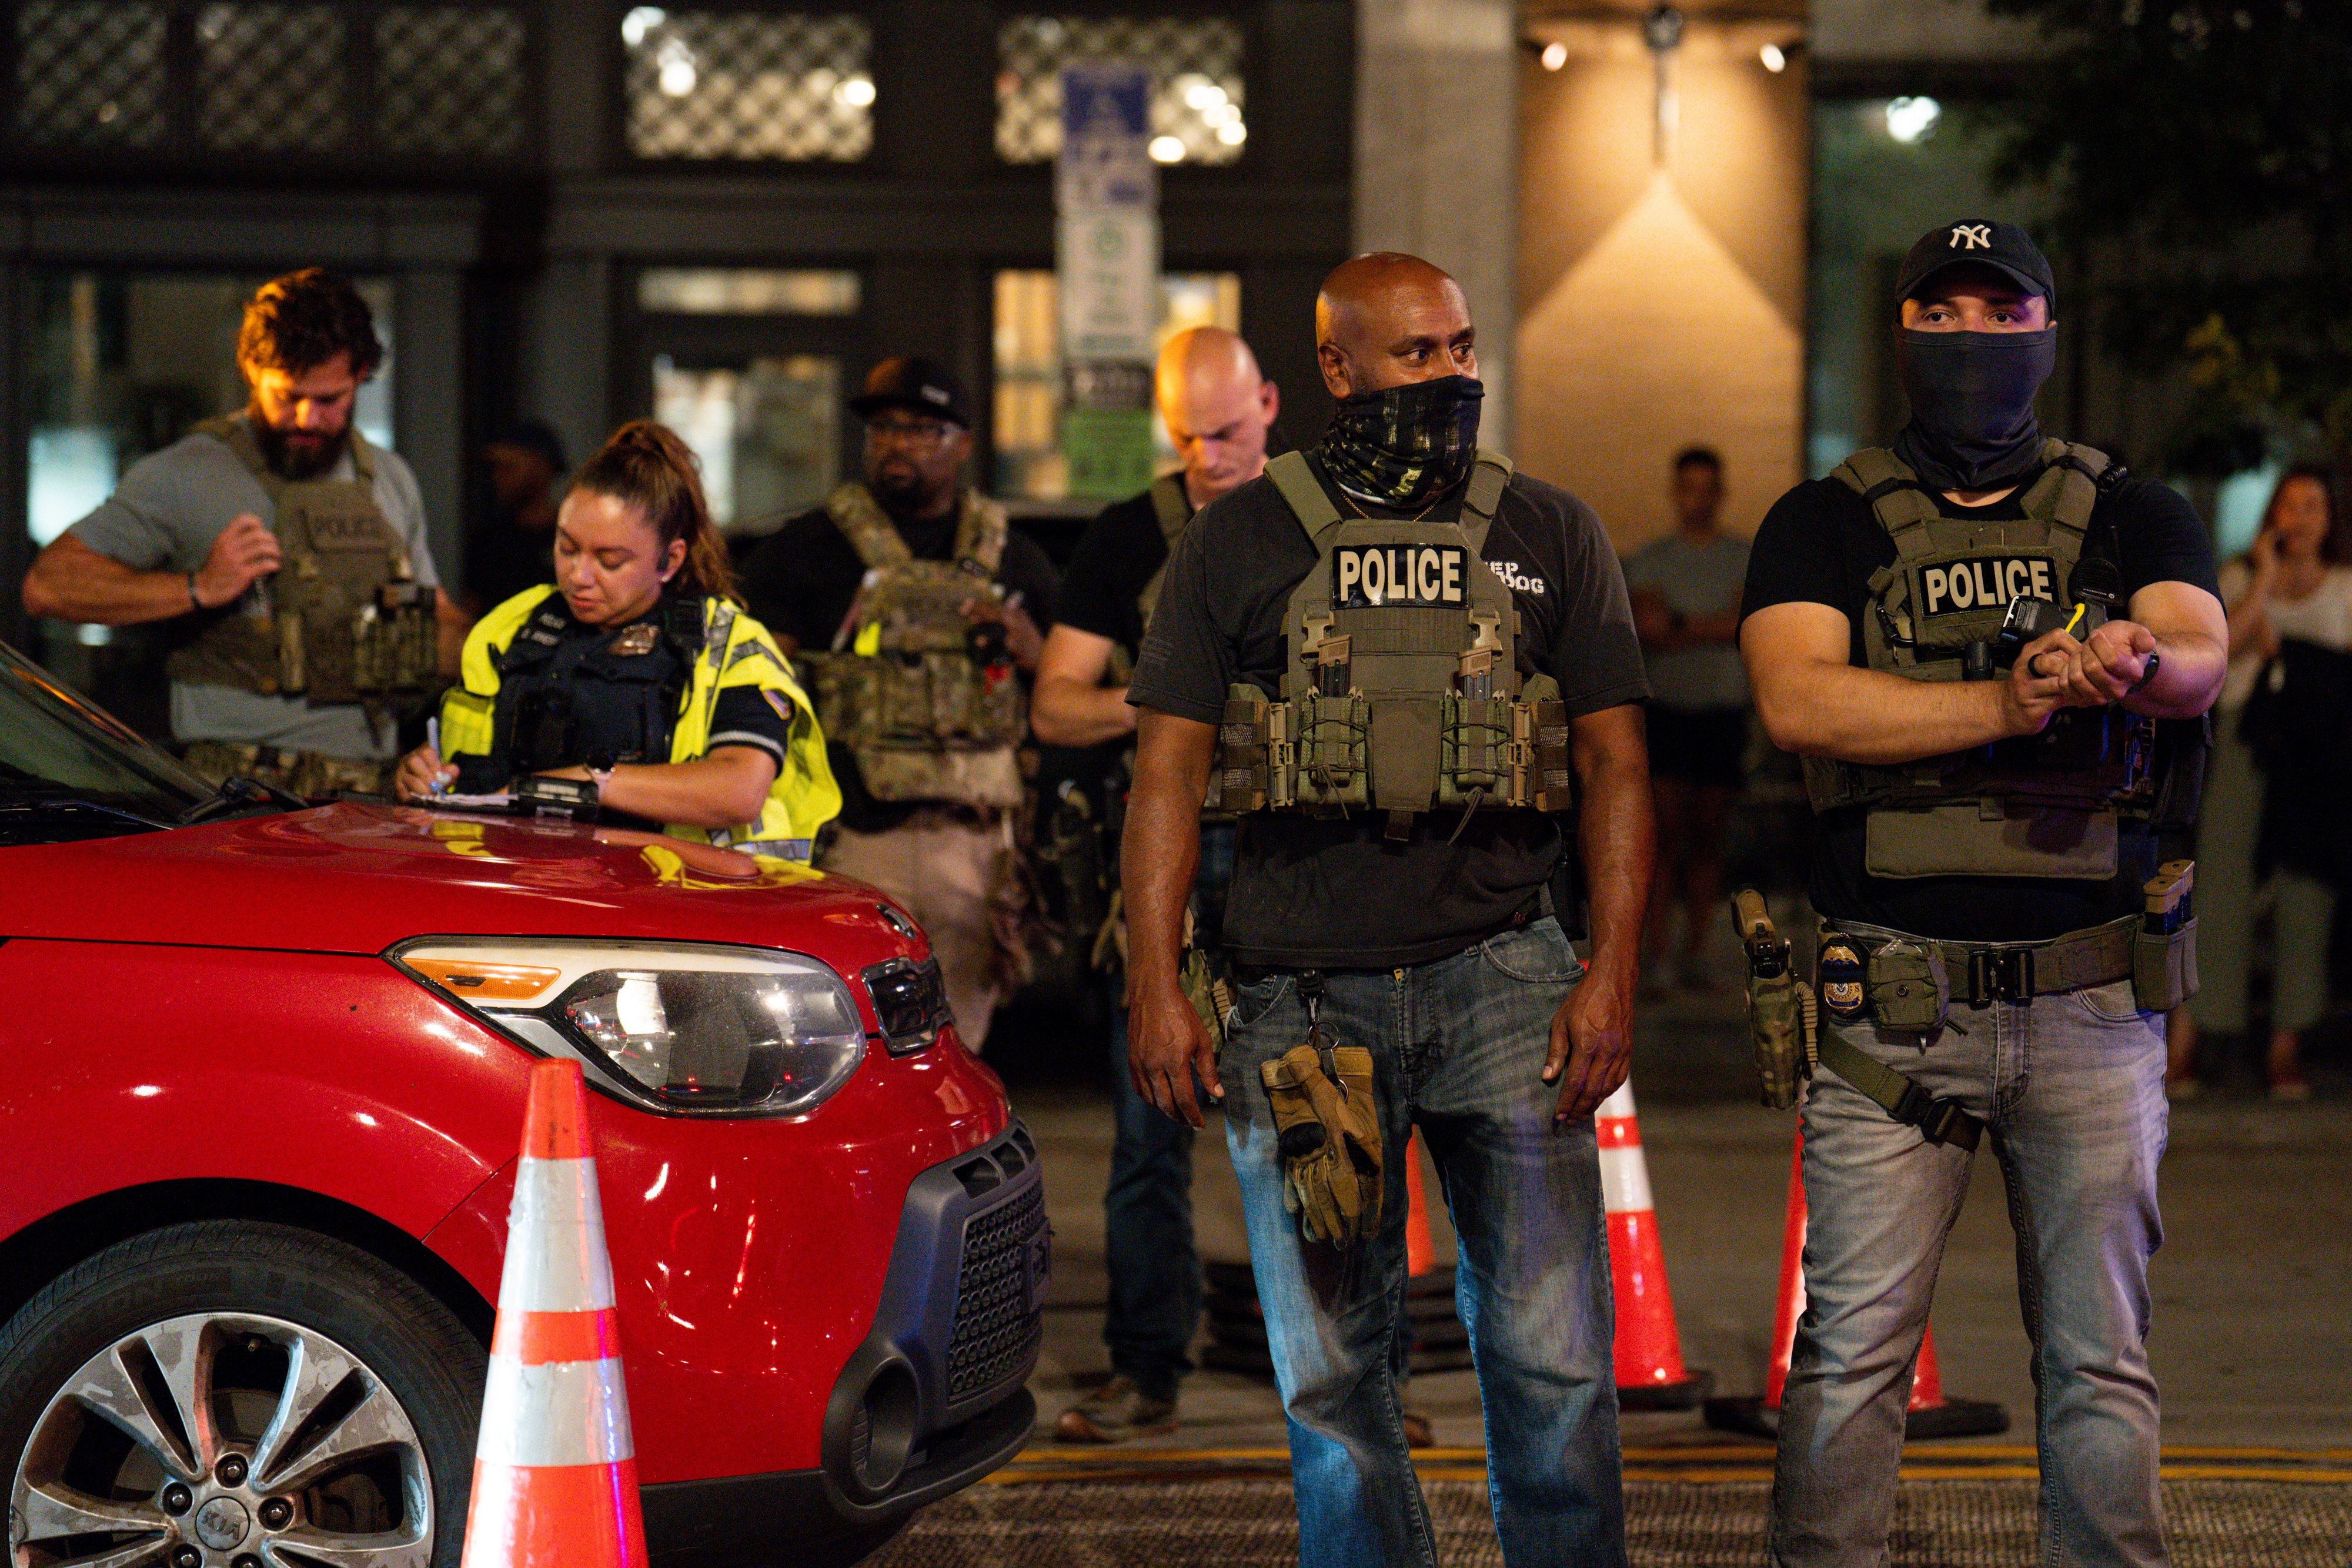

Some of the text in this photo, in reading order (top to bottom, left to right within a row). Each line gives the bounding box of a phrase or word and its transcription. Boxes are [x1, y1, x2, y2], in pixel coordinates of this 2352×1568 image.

[1340, 549, 1461, 601] POLICE
[1484, 561, 1519, 577] EP
[1926, 560, 2053, 613] POLICE
[203, 1510, 240, 1540] KIA
